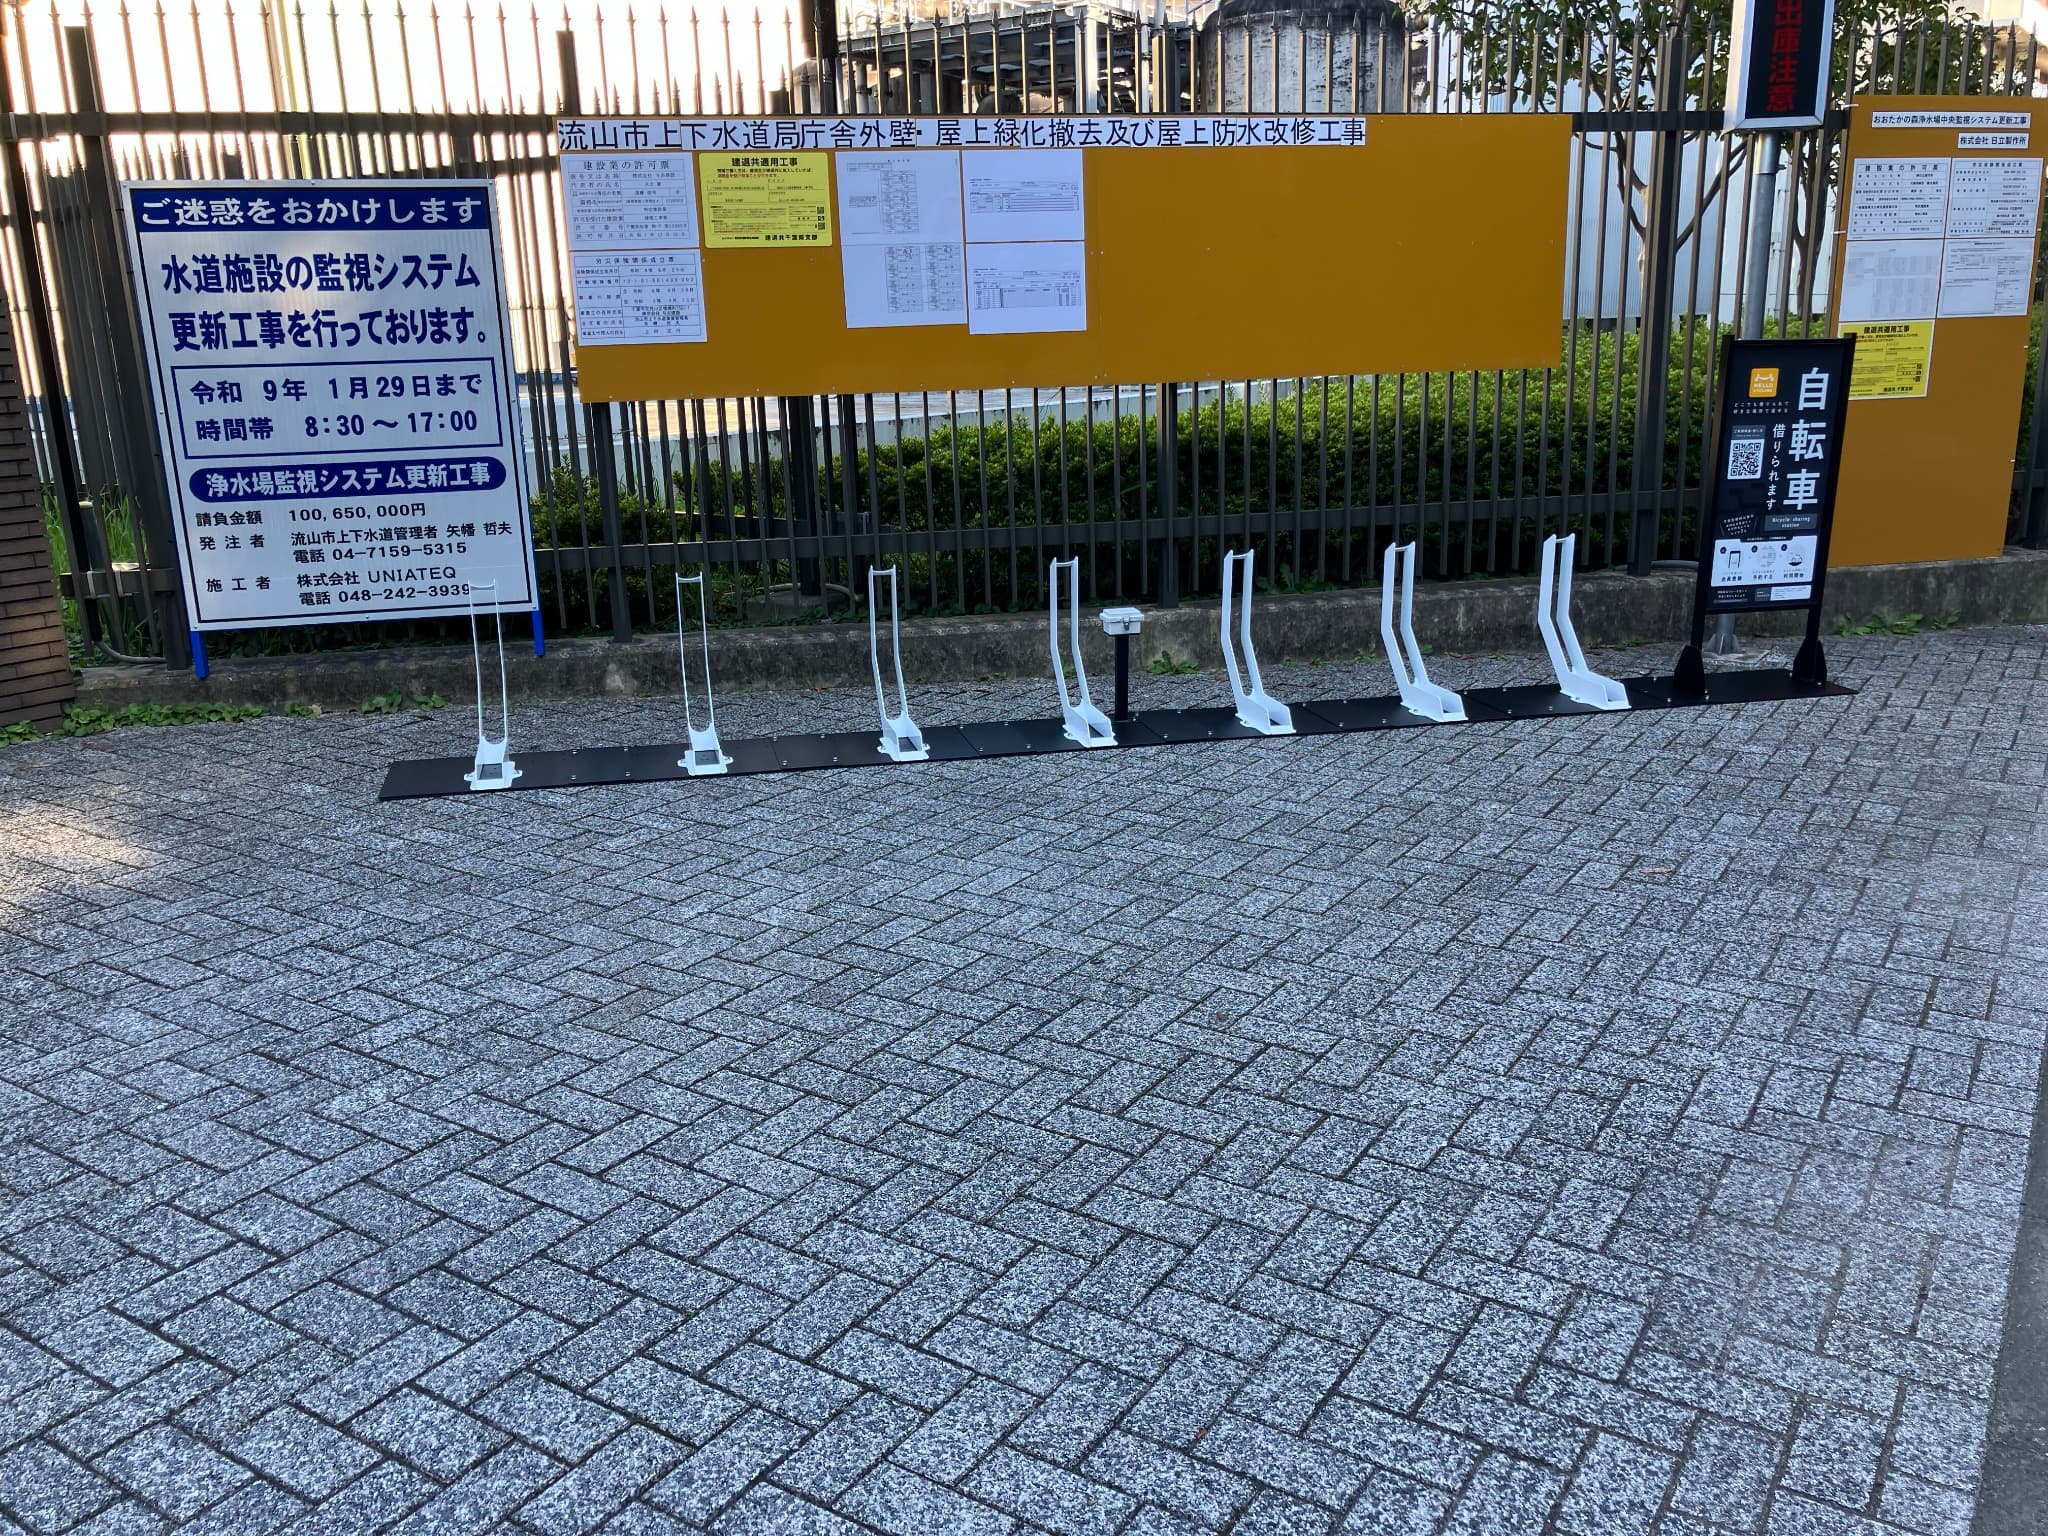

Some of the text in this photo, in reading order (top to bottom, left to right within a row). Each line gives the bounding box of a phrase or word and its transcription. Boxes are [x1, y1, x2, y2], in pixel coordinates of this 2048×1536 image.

[558, 118, 1364, 149] 流山市上下水道局庁舎外壁・屋上緑化撤去及び屋上防水改修工事
[1873, 115, 2027, 125] おおたかの森浄水場中央監視システム更新工事
[1960, 135, 2026, 145] 株式会社 日立製作所
[141, 196, 483, 227] ご迷惑をおかけします
[162, 252, 481, 295] 水道施設の監視システム
[168, 306, 487, 352] 更新工事を行っております。
[190, 379, 242, 405] 令和
[195, 416, 273, 442] 時間帯
[1783, 367, 1829, 511] 自転車
[206, 461, 491, 498] 浄水場監視システム更新工事
[1766, 423, 1787, 511] 借りられます
[195, 502, 426, 527] 請負金額 100,650,000円
[200, 521, 513, 550] 発注者 流山市上下水道管理者 矢幡 哲夫
[293, 549, 325, 563] 電話
[206, 566, 457, 593] 施工者 株式会社 UNIATEQ
[299, 591, 331, 606] 電話
